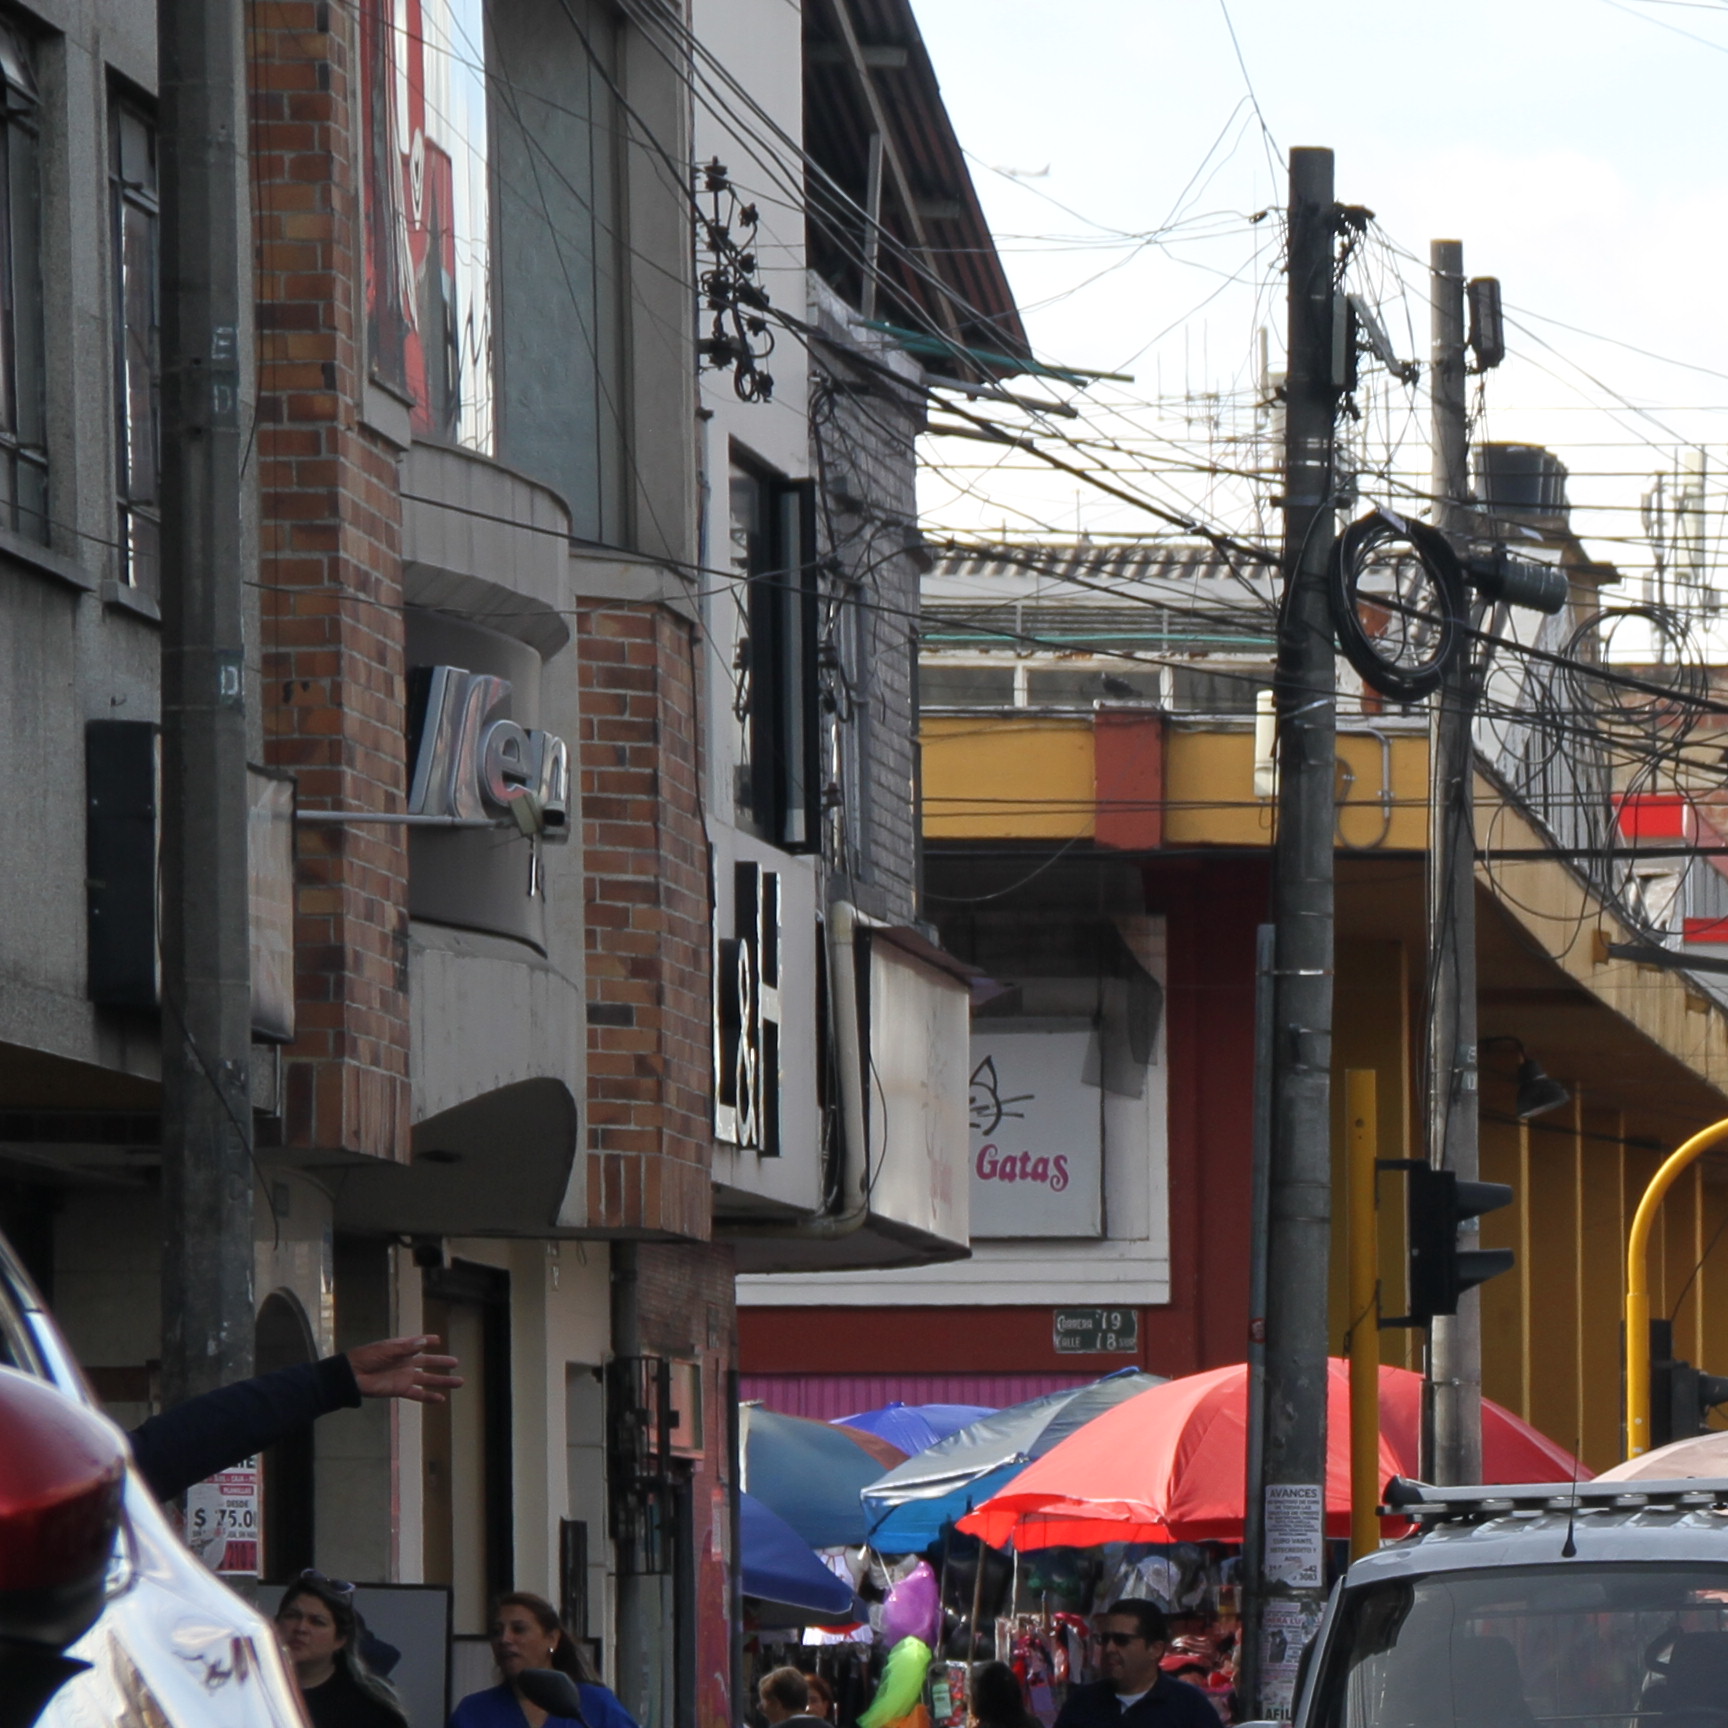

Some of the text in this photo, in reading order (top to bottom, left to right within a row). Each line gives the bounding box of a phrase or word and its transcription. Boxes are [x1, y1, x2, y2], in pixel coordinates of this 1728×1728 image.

[976, 1143, 1069, 1192] Gatas
[1101, 1311, 1122, 1330] 19
[1096, 1332, 1117, 1351] 18
[1269, 1488, 1317, 1498] AVANCES
[193, 1507, 206, 1528] $
